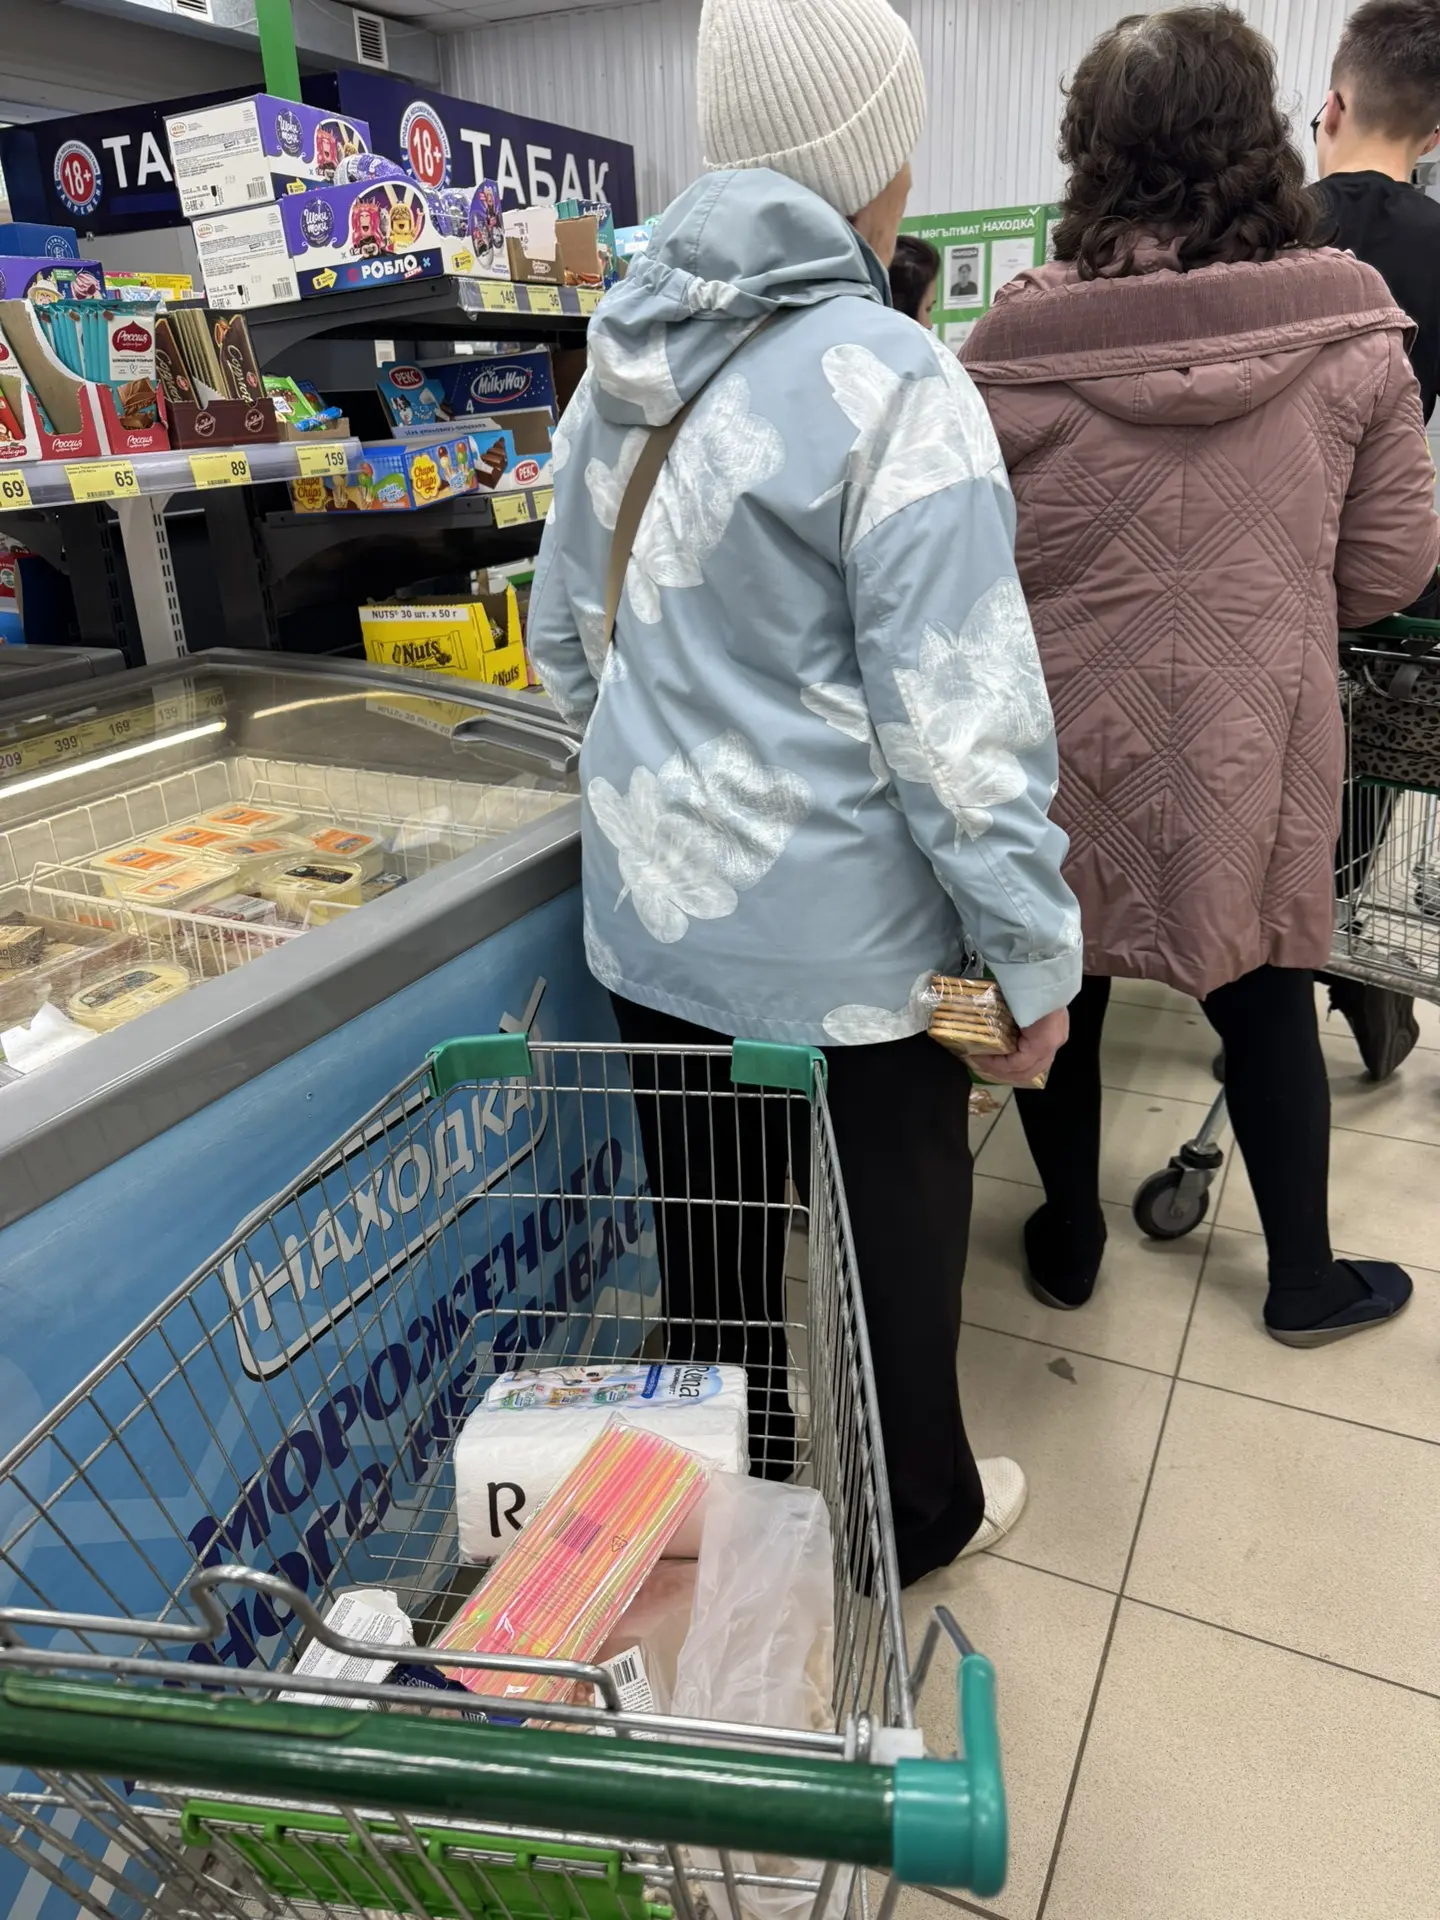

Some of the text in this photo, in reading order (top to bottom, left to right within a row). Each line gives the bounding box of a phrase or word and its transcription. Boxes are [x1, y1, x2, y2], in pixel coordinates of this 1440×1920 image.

[413, 127, 442, 178] 18+
[460, 128, 609, 208] ТАБАК
[65, 160, 92, 196] 18+
[982, 217, 1035, 233] НАХОДКА
[361, 254, 418, 279] РОБЛО
[116, 329, 149, 344] Россия
[52, 438, 83, 451] Россия
[127, 434, 153, 447] Россия
[325, 451, 345, 467] 159
[231, 461, 247, 476] 89
[413, 464, 435, 478] Chupa
[114, 470, 134, 488] 65
[2, 480, 25, 499] 69
[401, 609, 412, 618] 30
[439, 609, 450, 618] 50
[402, 639, 441, 665] Nuts
[497, 663, 520, 687] Nuts
[108, 719, 131, 736] 169
[54, 735, 78, 753] 399
[0, 751, 23, 770] 209
[249, 1075, 536, 1332] НАХОДКА
[493, 1176, 650, 1375] БЫВАЕ
[187, 1137, 623, 1590] МОРОЖЕНОГО
